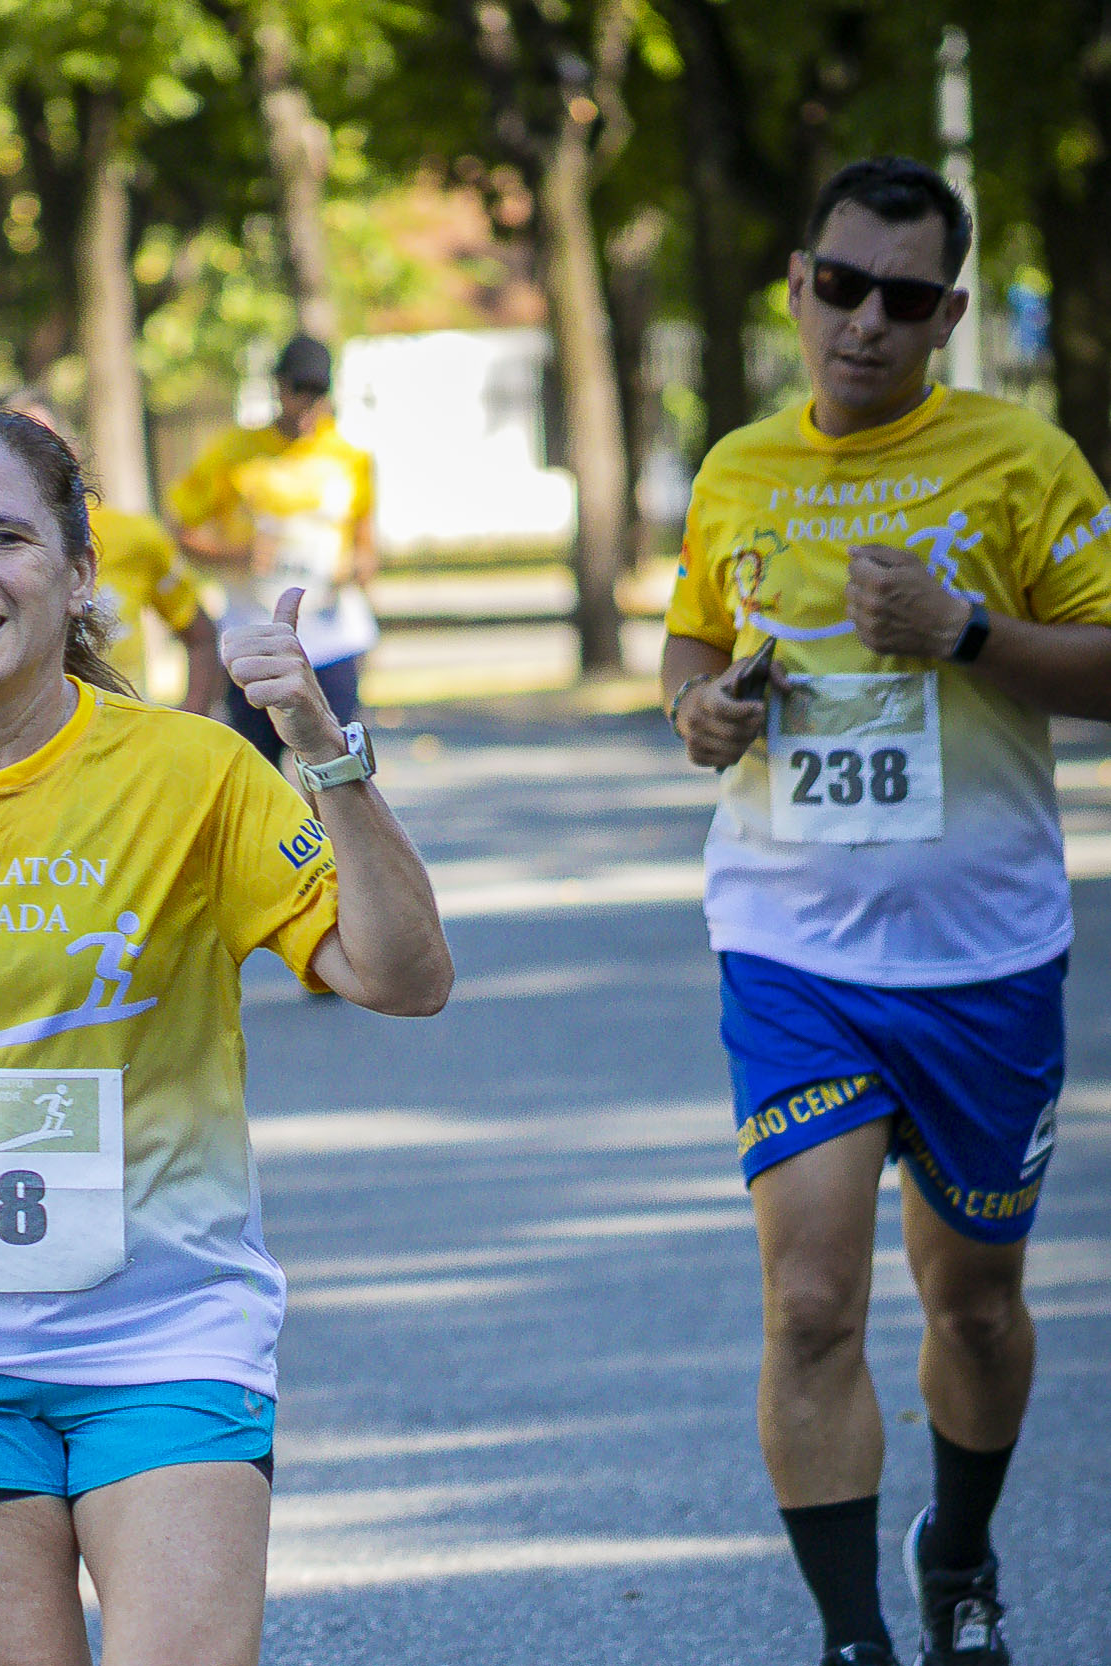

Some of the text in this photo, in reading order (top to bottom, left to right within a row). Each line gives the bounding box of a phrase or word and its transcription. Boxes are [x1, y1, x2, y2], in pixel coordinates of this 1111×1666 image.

[793, 473, 944, 507] MARATÓN
[785, 509, 910, 542] DORADA
[790, 747, 909, 805] 238
